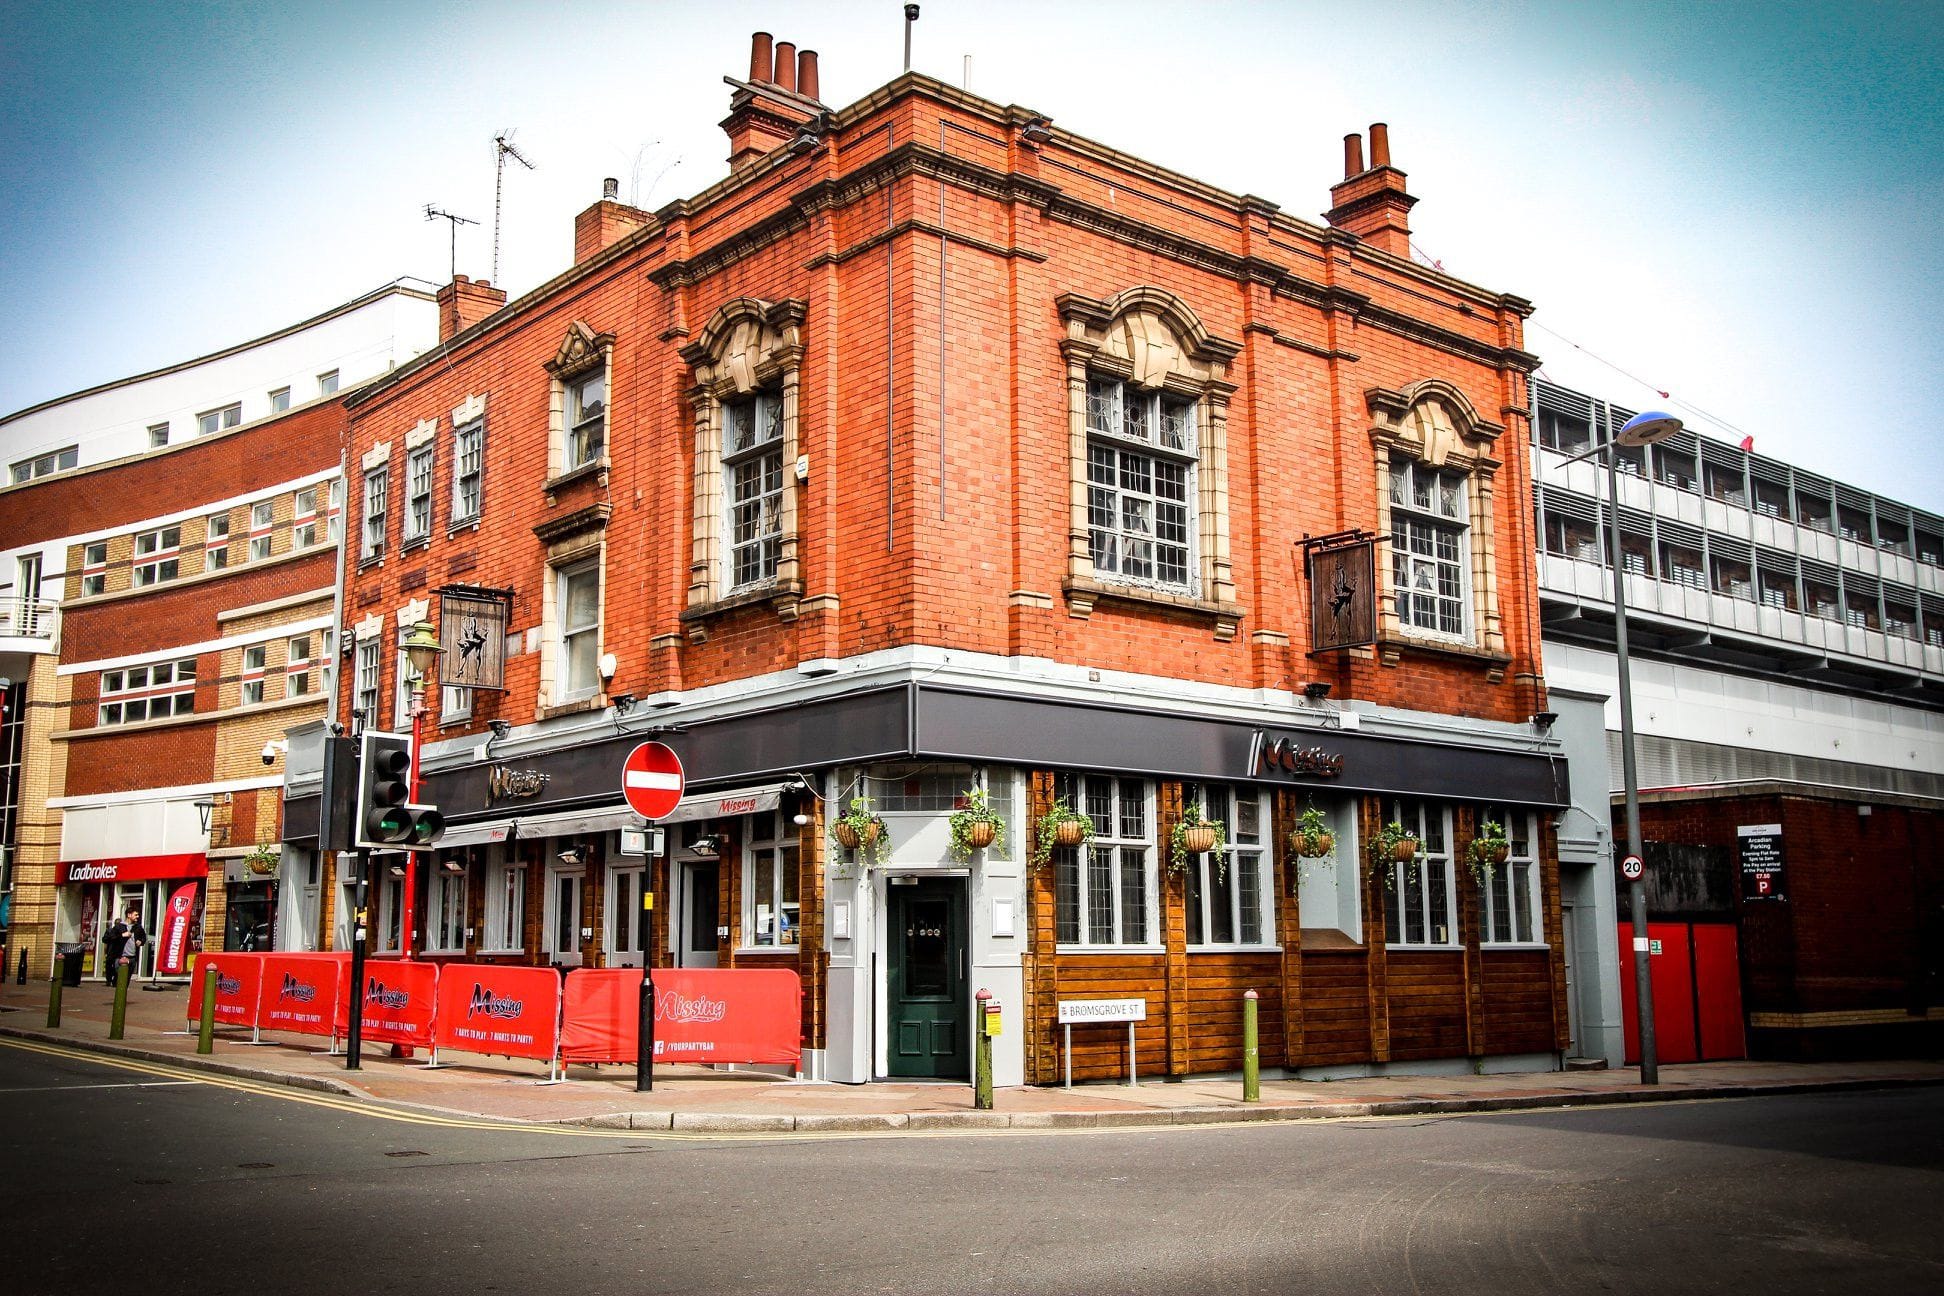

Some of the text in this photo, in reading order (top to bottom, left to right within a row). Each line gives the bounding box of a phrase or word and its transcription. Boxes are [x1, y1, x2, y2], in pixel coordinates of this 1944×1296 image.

[718, 798, 756, 815] Missing
[69, 862, 118, 880] Ladbrokes
[1624, 862, 1641, 873] 20
[1760, 881, 1768, 893] P
[168, 916, 185, 969] clonezone
[280, 972, 315, 1003] Missing
[363, 976, 409, 1010] Missing
[468, 982, 522, 1020] Missing
[1070, 1004, 1127, 1017] BROMSGROVE
[1129, 1004, 1139, 1014] ST
[476, 1031, 487, 1040] PLAY
[494, 1032, 510, 1042] NIGHTS
[667, 1042, 715, 1051] /YOURPARTYBAR
